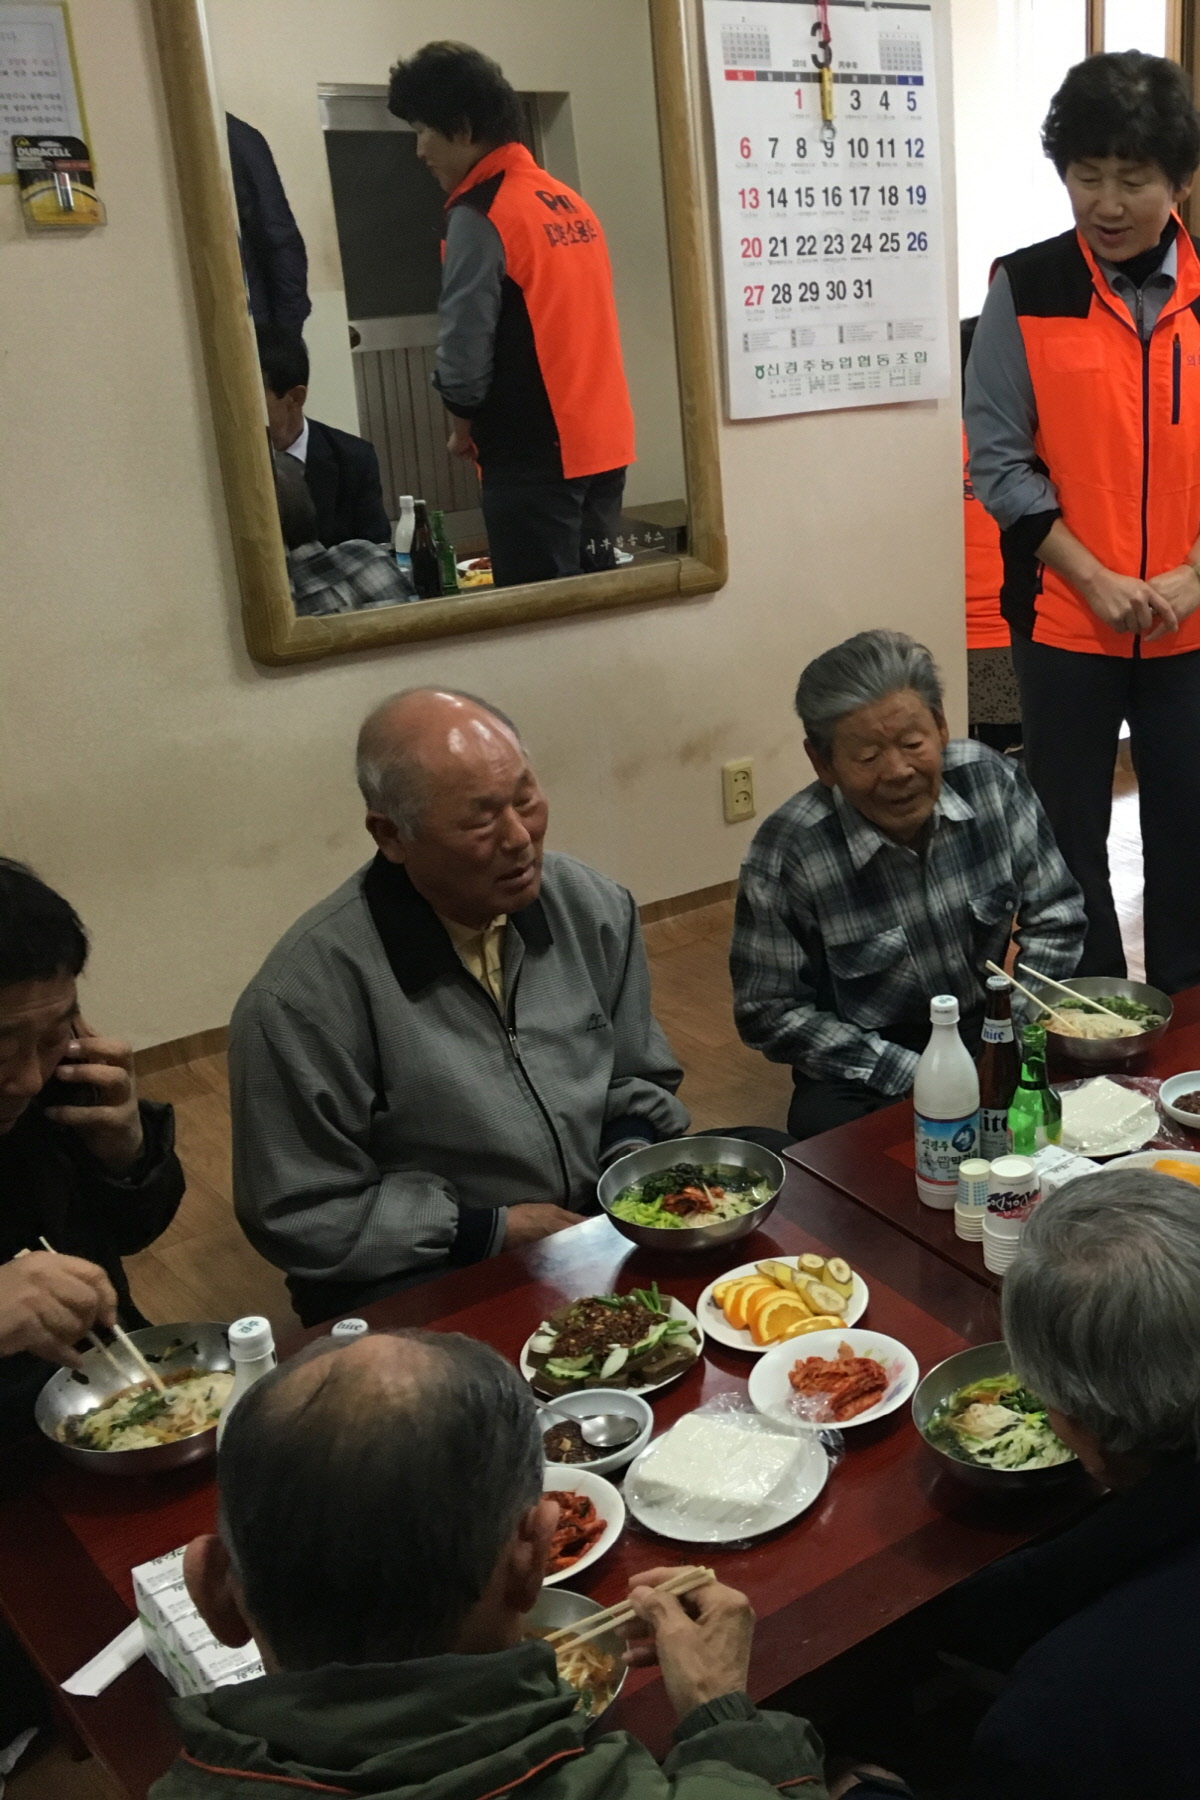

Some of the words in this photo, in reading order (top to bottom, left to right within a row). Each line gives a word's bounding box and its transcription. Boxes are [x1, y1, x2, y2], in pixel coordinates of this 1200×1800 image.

[811, 22, 832, 68] 3
[794, 88, 802, 109] 1
[850, 89, 862, 111] 3
[879, 90, 890, 111] 4
[907, 91, 917, 112] 5
[16, 146, 72, 157] DURACELL
[740, 137, 751, 159] 6
[768, 137, 779, 159] 7
[796, 137, 807, 159] 8
[847, 137, 869, 159] 10
[876, 138, 895, 158] 11
[905, 137, 925, 158] 12
[738, 187, 760, 209] 13
[767, 187, 788, 208] 14
[795, 186, 815, 208] 15
[822, 185, 842, 207] 16
[849, 185, 871, 206] 17
[878, 185, 899, 206] 18
[906, 184, 927, 206] 19
[740, 237, 762, 259] 20
[768, 236, 788, 258] 21
[796, 234, 818, 256] 22
[823, 233, 845, 255] 23
[850, 233, 873, 254] 24
[879, 232, 901, 253] 25
[906, 231, 928, 252] 26
[743, 285, 765, 307] 27
[771, 282, 793, 305] 28
[798, 281, 820, 303] 29
[826, 279, 847, 301] 30
[853, 278, 873, 300] 31
[767, 351, 928, 377] 신경주농업협동조합
[983, 1028, 1005, 1041] hite
